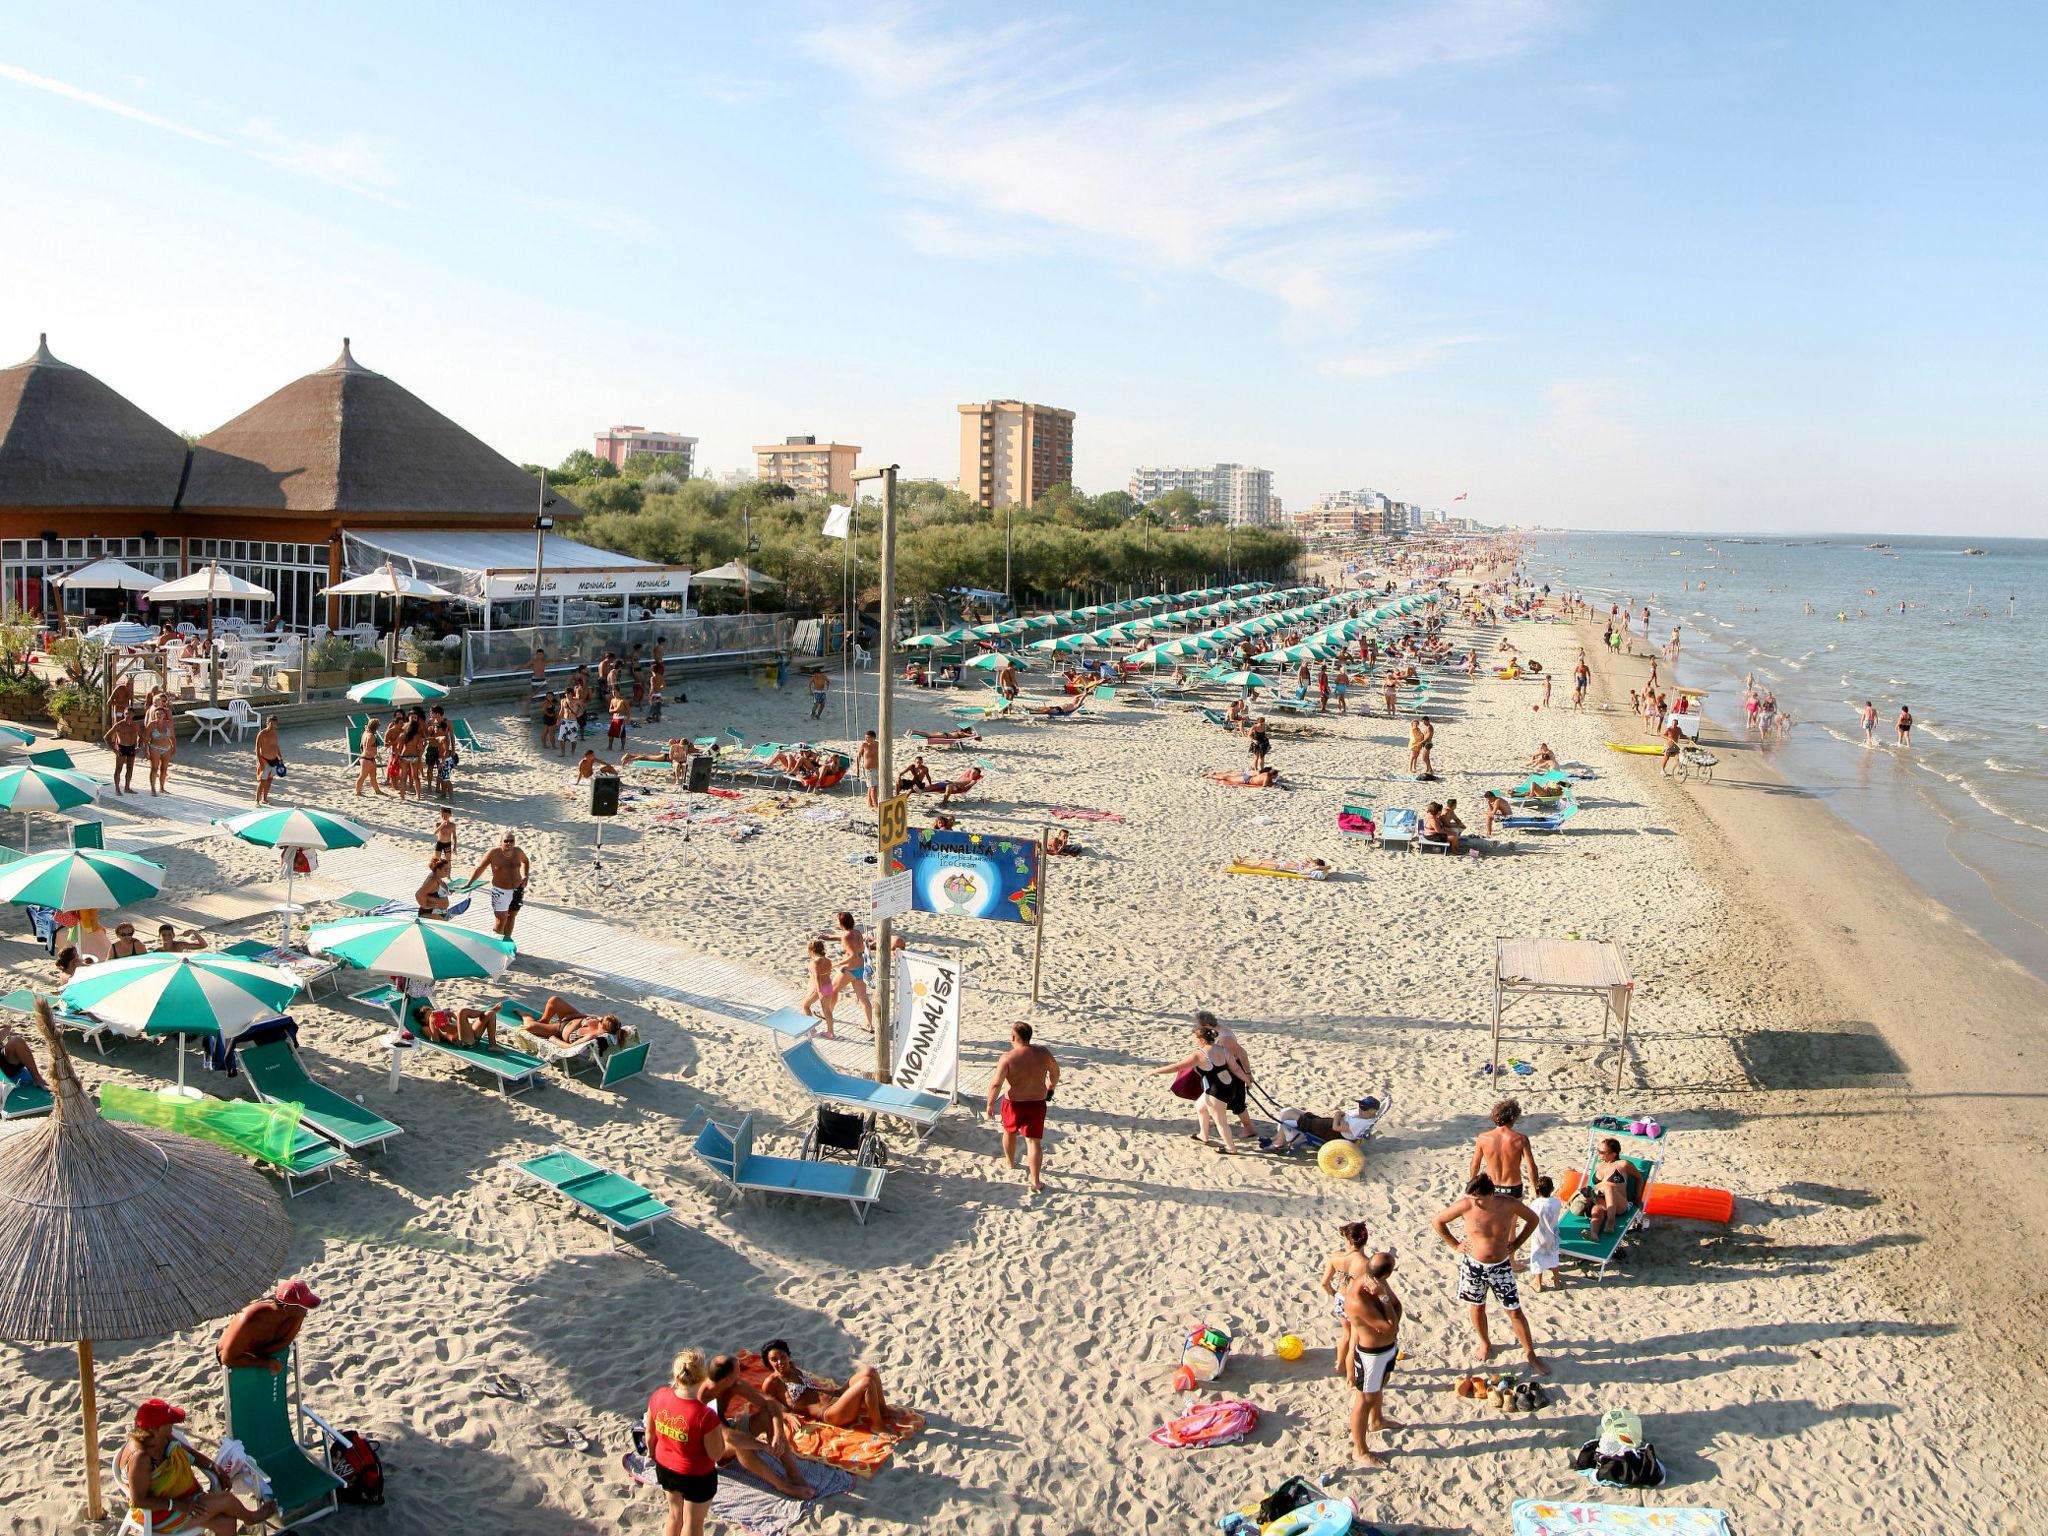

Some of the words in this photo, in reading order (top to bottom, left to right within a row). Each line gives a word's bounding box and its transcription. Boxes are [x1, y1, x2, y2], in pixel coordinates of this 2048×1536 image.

[882, 801, 906, 844] 59
[919, 840, 994, 856] MONNALISA
[896, 967, 956, 1090] MONNALISA
